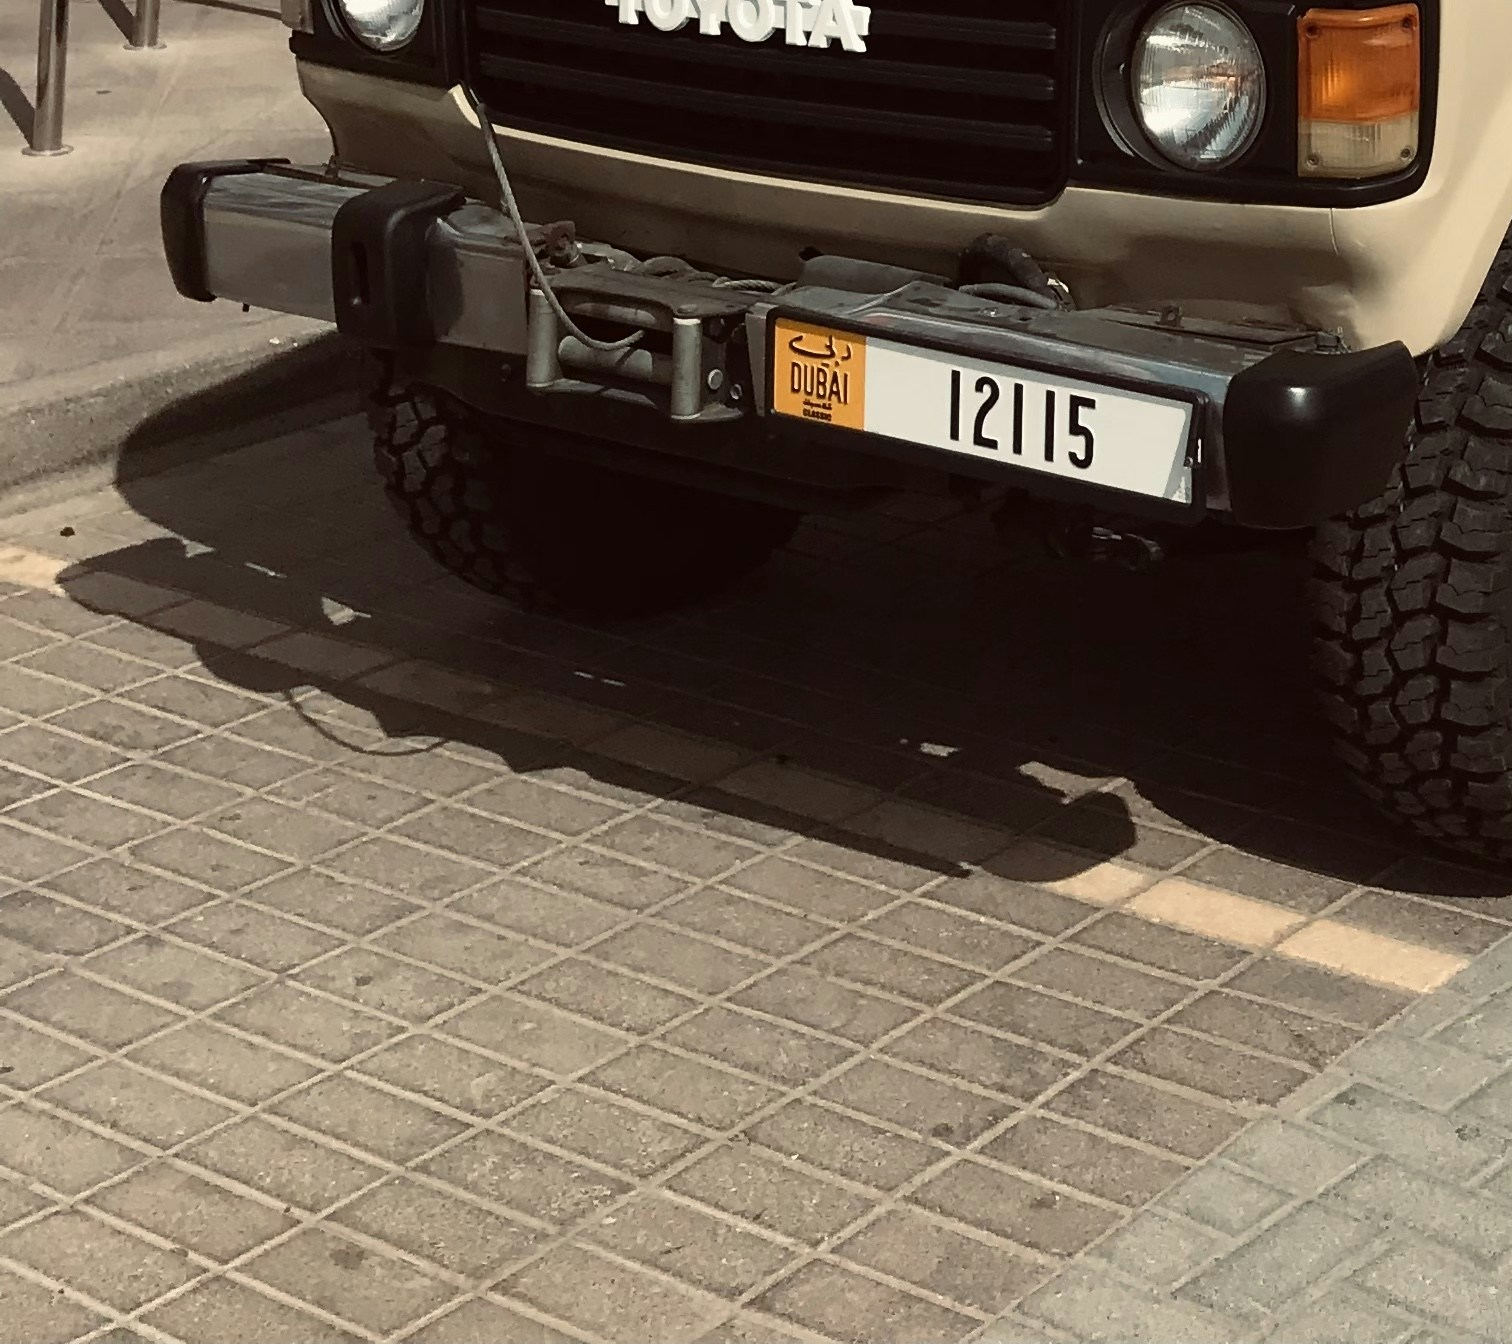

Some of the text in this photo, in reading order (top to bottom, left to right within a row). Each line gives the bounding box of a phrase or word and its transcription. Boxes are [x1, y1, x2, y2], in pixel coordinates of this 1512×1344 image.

[788, 334, 853, 368] دبي
[790, 360, 849, 406] DUBAI
[948, 369, 1097, 470] 12115
